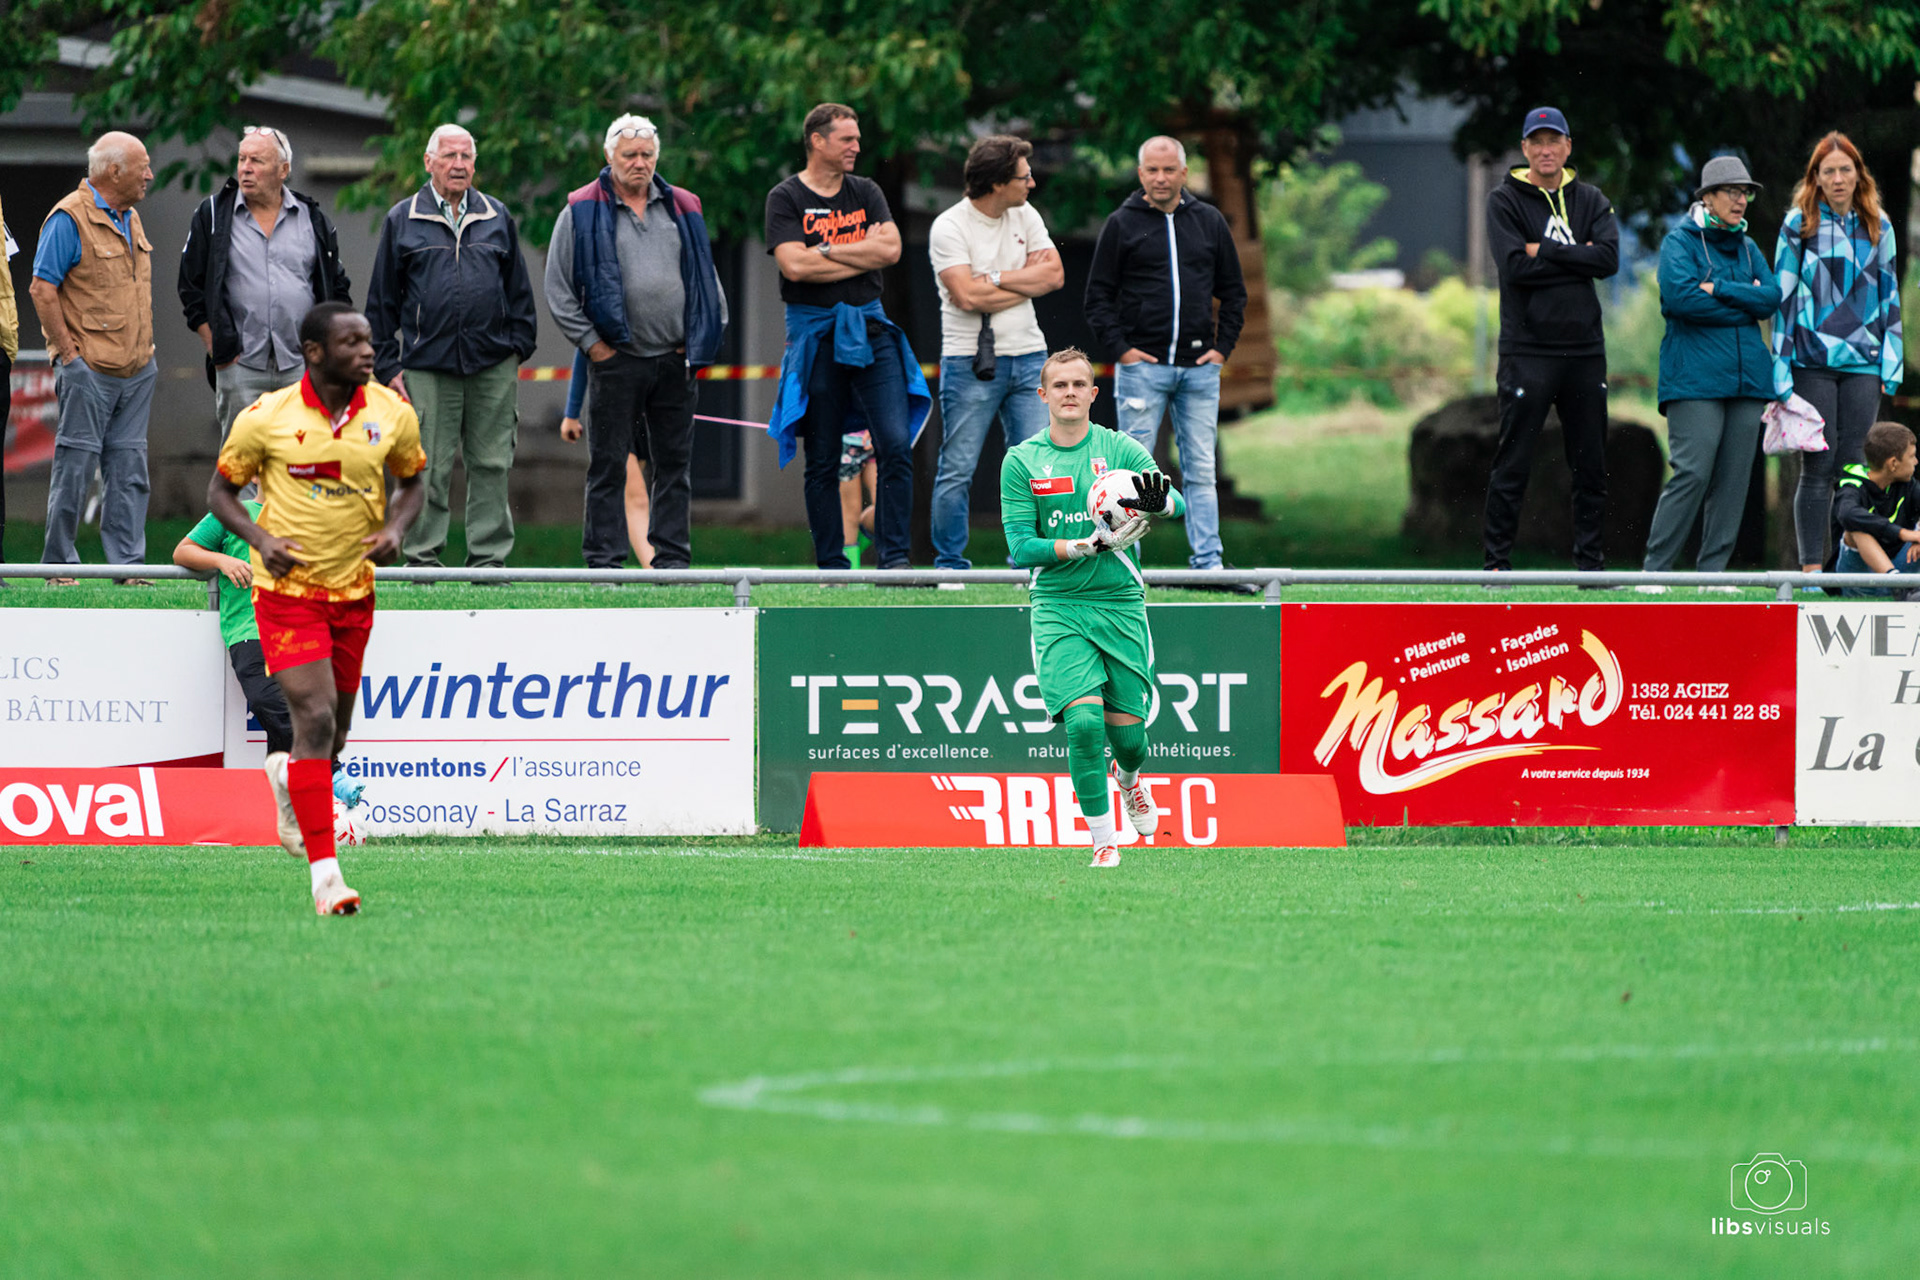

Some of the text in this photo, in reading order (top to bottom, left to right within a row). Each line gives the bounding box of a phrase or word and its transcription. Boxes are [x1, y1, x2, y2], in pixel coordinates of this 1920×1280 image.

[803, 208, 867, 236] Caribbean
[1031, 480, 1052, 490] Hoval
[1403, 631, 1466, 662] Plâtrerie
[1500, 623, 1559, 652] Façades
[1409, 652, 1471, 682] Peinture
[1506, 642, 1570, 673] Isolation
[361, 661, 730, 720] winterthur
[791, 674, 1247, 734] TERRASRT
[1631, 682, 1729, 699] 1352 AGIEZ
[6, 694, 169, 723] BÂTIMENT
[1313, 629, 1624, 795] Massard
[1629, 704, 1780, 720] Tél. 024 441 22 85
[808, 743, 880, 759] surfaces
[1806, 716, 1886, 772] La
[1521, 767, 1650, 781] A votre service depuis 1934
[505, 798, 535, 823] La
[545, 798, 627, 823] Sarraz
